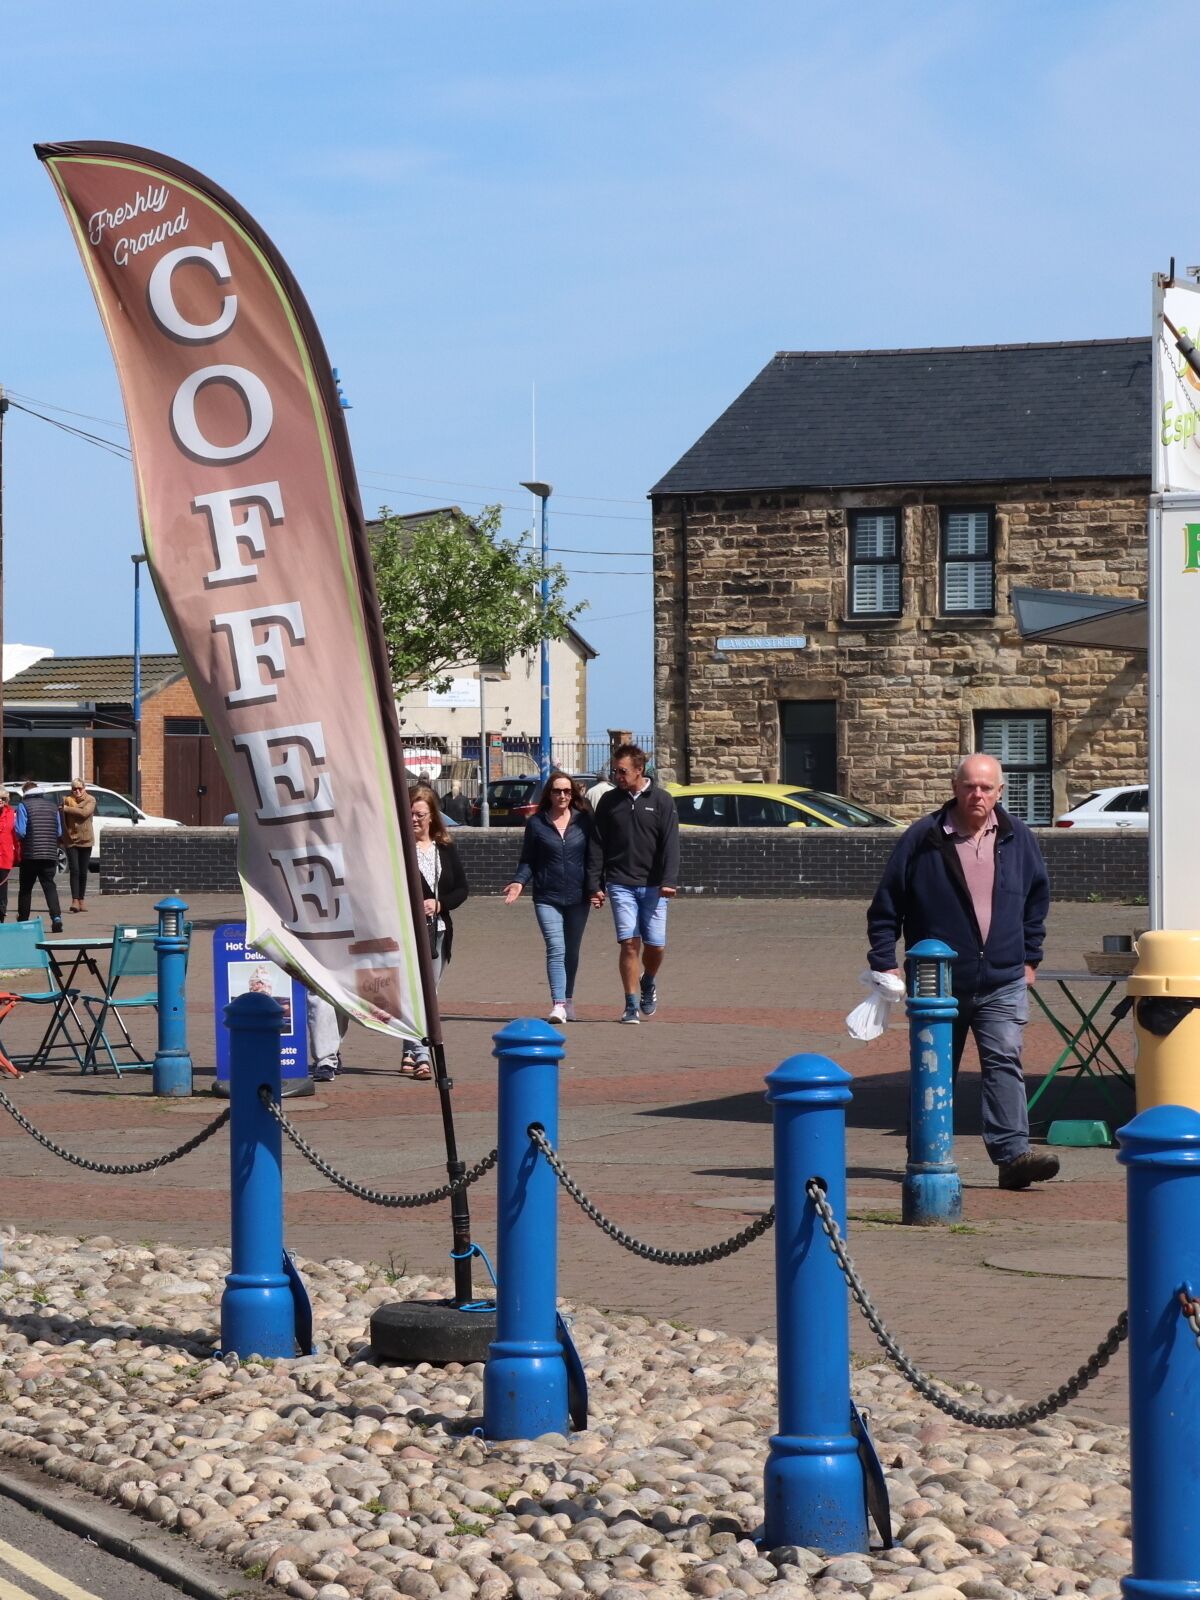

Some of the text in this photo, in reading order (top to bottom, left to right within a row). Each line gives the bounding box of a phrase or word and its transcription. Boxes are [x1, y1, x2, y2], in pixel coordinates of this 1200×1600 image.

[88, 184, 170, 246] Freshly
[113, 207, 189, 266] Ground
[147, 240, 356, 940] COFFEE
[722, 637, 803, 649] LAWSON STREET
[225, 942, 243, 951] Hot
[362, 976, 391, 994] Coffee
[280, 1047, 297, 1055] atte
